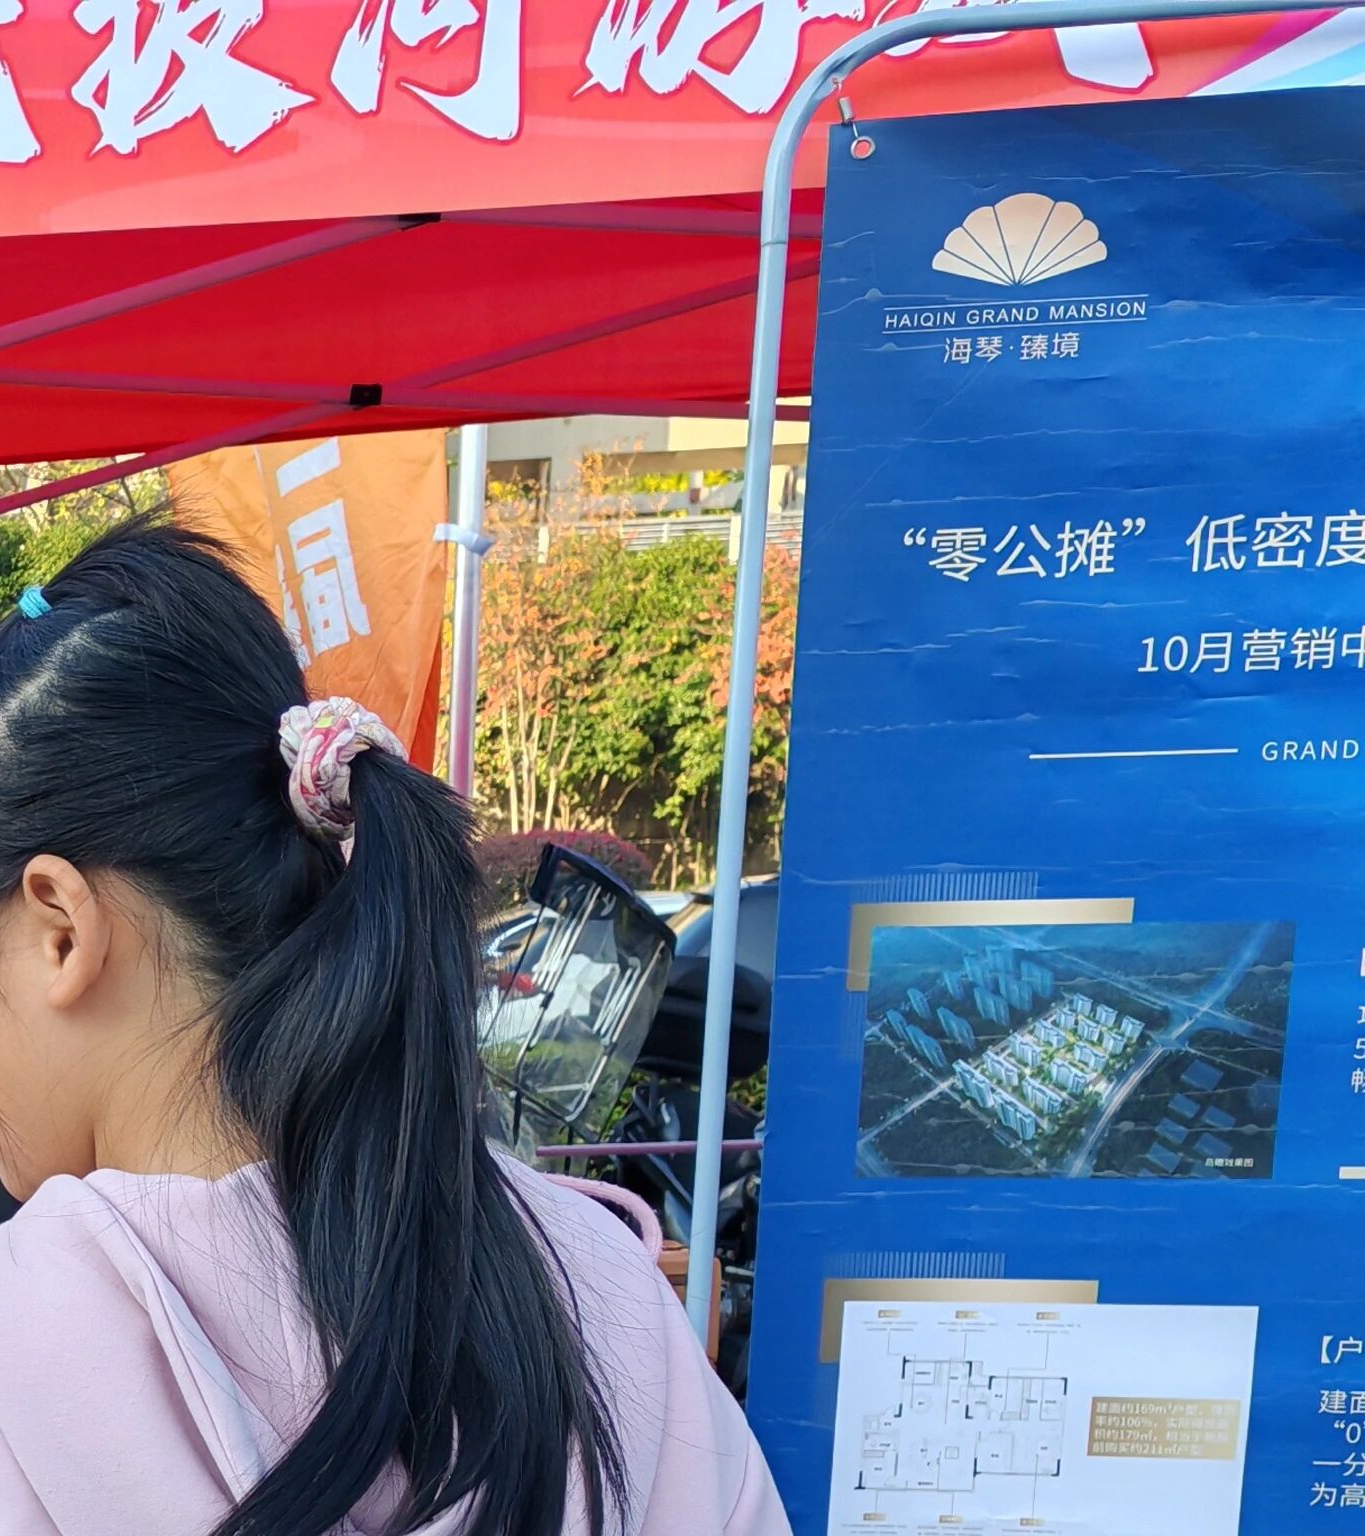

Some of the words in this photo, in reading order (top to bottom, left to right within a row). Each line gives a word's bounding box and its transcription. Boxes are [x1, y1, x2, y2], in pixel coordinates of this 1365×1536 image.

[884, 312, 956, 329] HAIQIN
[966, 306, 1039, 325] GRAND
[1049, 301, 1147, 321] MANSION
[902, 516, 1147, 583] “零公摊”
[1185, 508, 1365, 573] 低密度
[1261, 739, 1360, 762] GRAND
